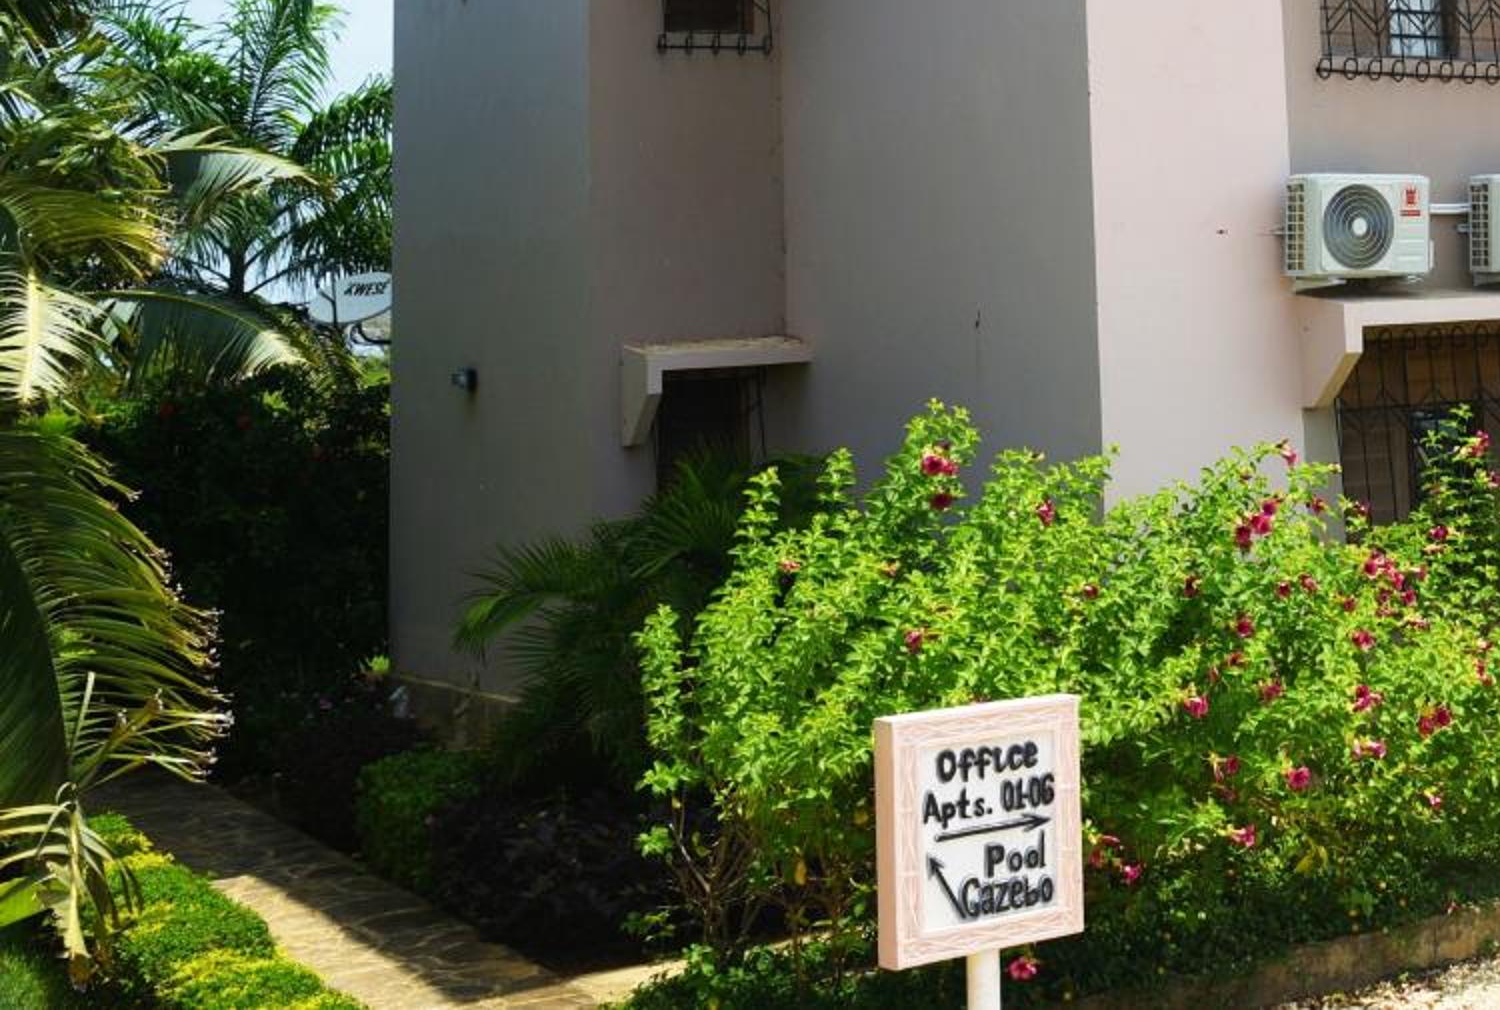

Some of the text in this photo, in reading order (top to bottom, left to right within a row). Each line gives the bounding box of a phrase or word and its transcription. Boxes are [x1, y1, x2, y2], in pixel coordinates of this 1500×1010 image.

[936, 741, 1038, 783] Office
[923, 773, 1054, 828] Apts. 01-06
[985, 829, 1046, 877] Pool
[962, 876, 1053, 917] Gazebo
